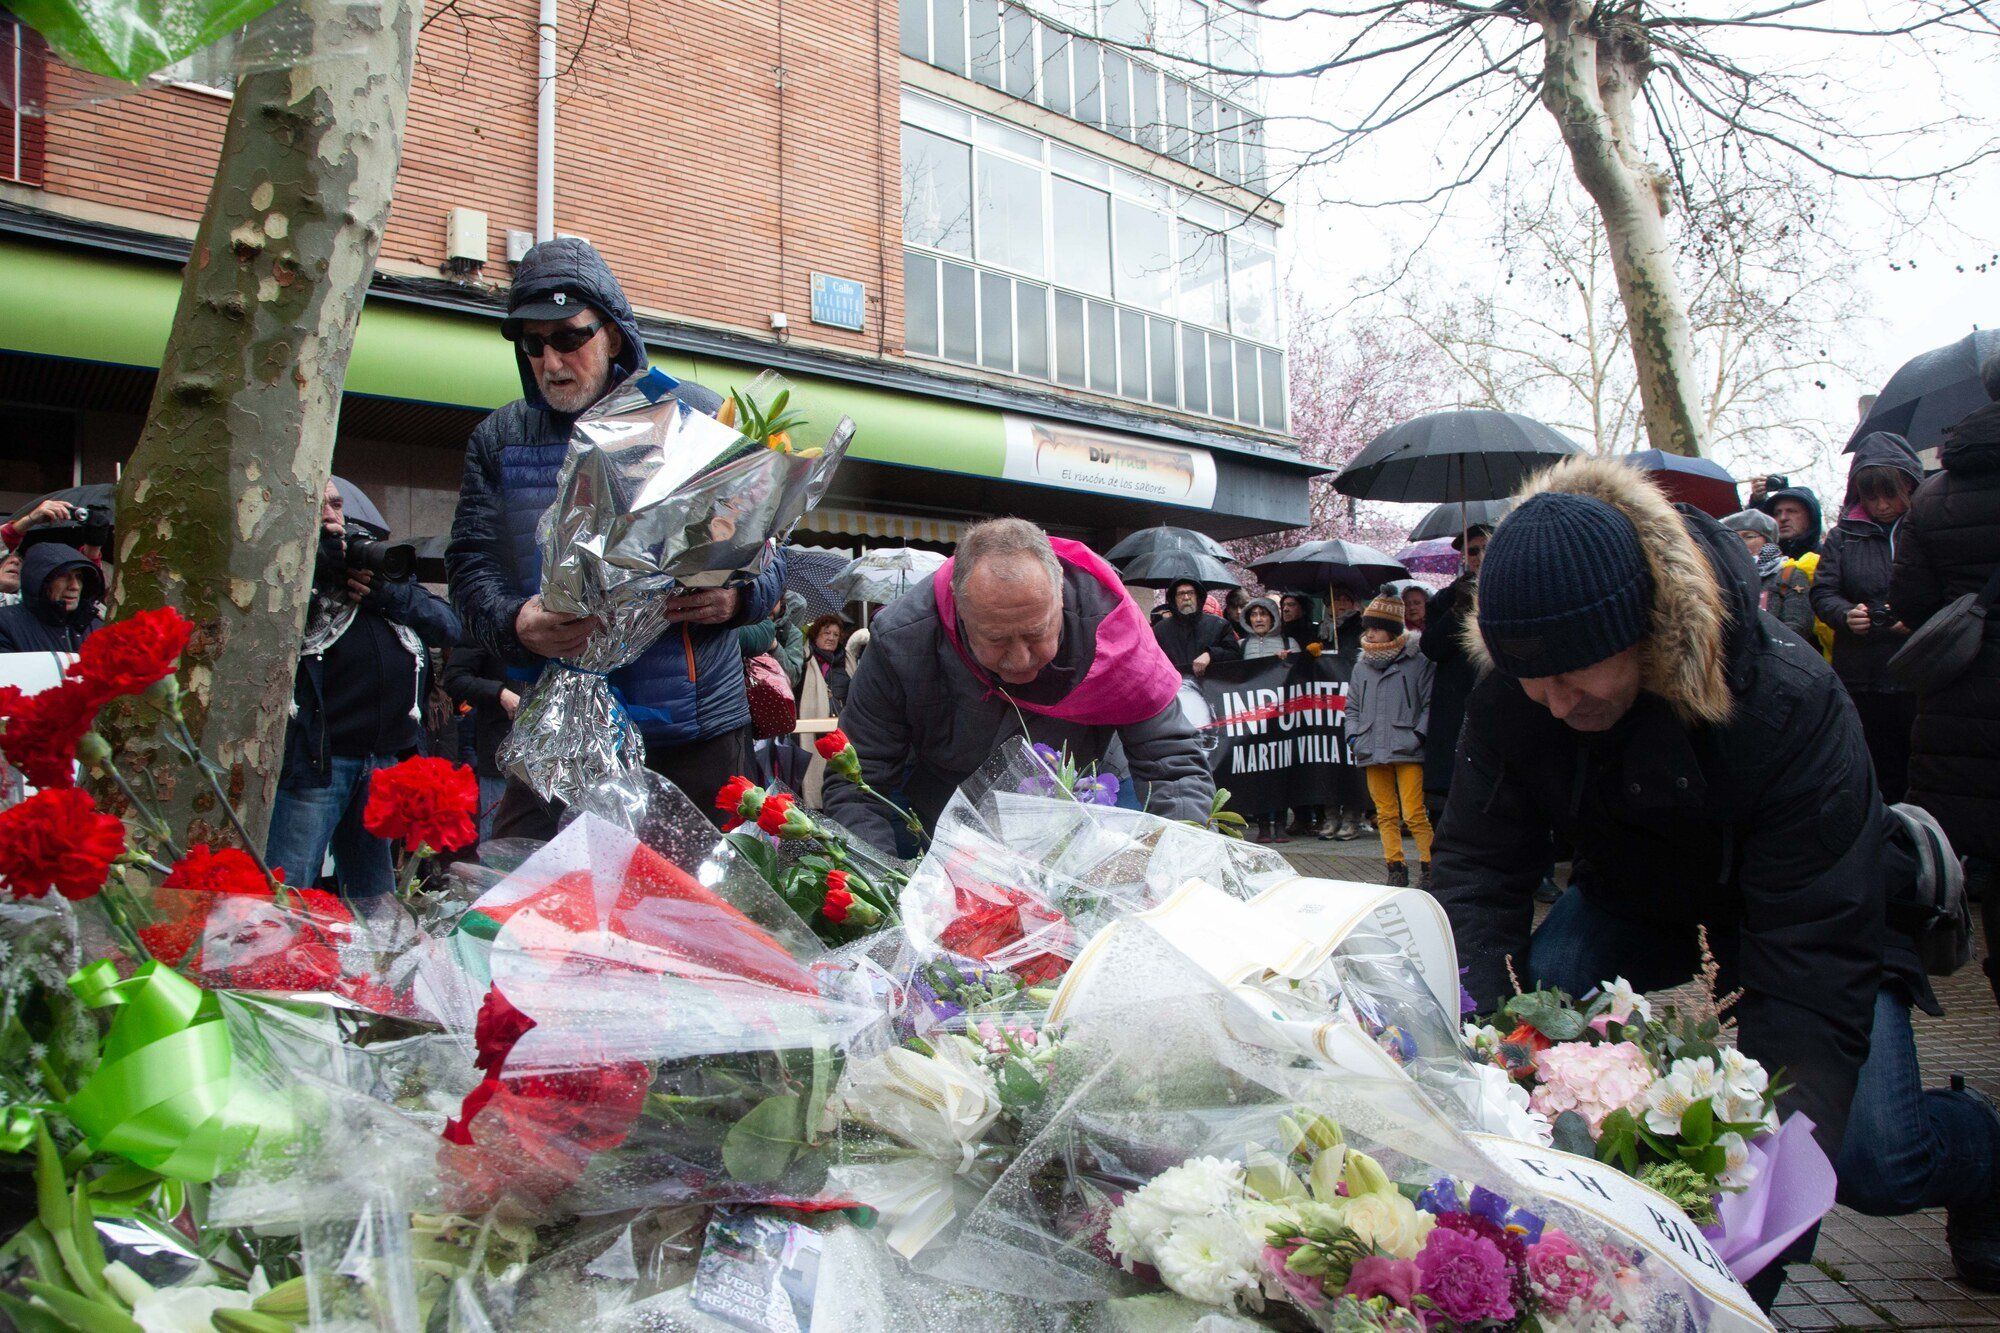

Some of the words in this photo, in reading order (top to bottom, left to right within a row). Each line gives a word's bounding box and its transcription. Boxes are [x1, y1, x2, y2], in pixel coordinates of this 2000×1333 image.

[832, 281, 854, 295] Calle
[1061, 469, 1071, 479] El
[1074, 472, 1104, 485] rincón
[1107, 476, 1119, 487] de
[1120, 478, 1133, 490] los
[1135, 480, 1166, 495] sabores
[1231, 738, 1293, 774] MARTIN
[1297, 735, 1341, 764] VILLA
[1643, 1203, 1740, 1285] BILD
